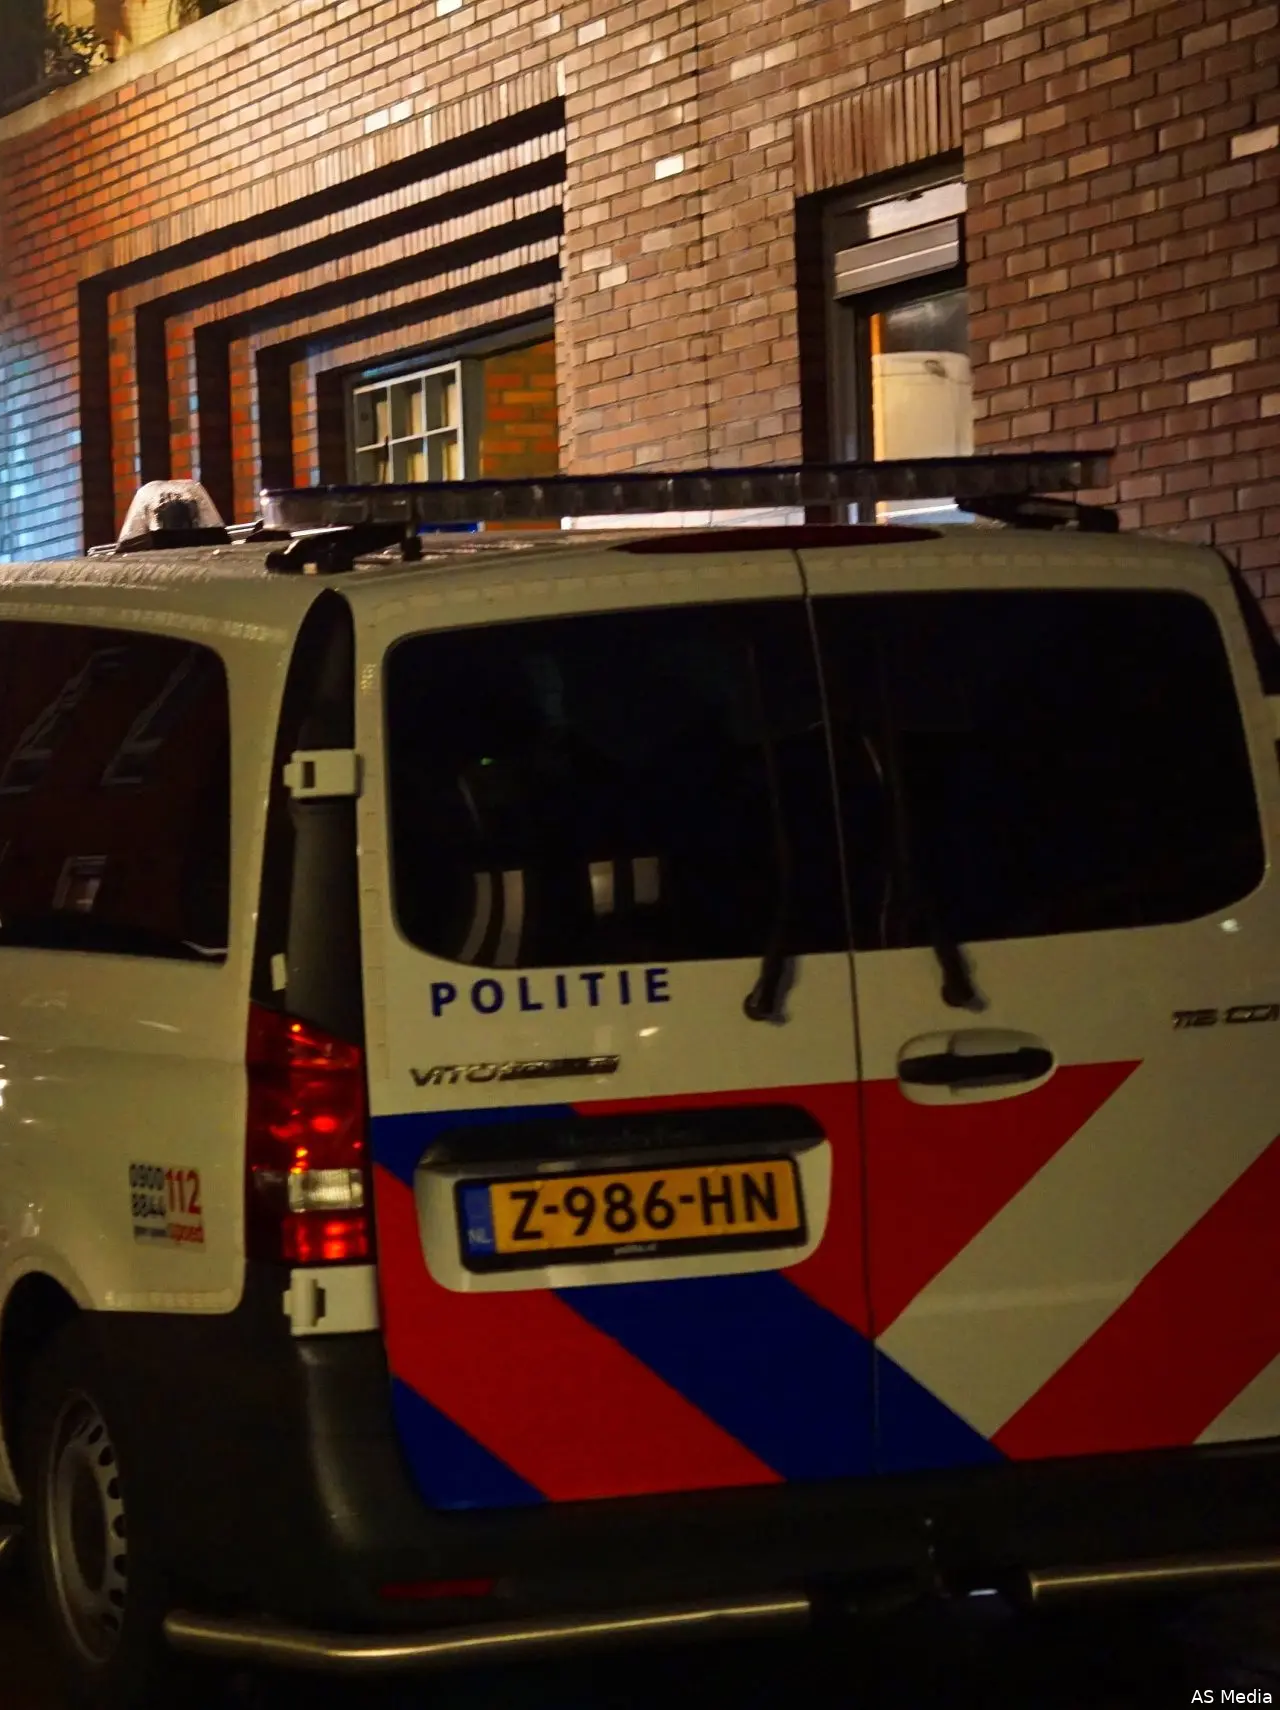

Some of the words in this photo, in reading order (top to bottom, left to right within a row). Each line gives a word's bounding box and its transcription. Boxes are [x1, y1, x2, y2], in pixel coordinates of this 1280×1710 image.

[430, 968, 672, 1017] POLITIE
[410, 1062, 503, 1087] VITO
[165, 1167, 202, 1215] 112
[508, 1171, 780, 1242] Z-986-HN
[468, 1228, 491, 1245] NL
